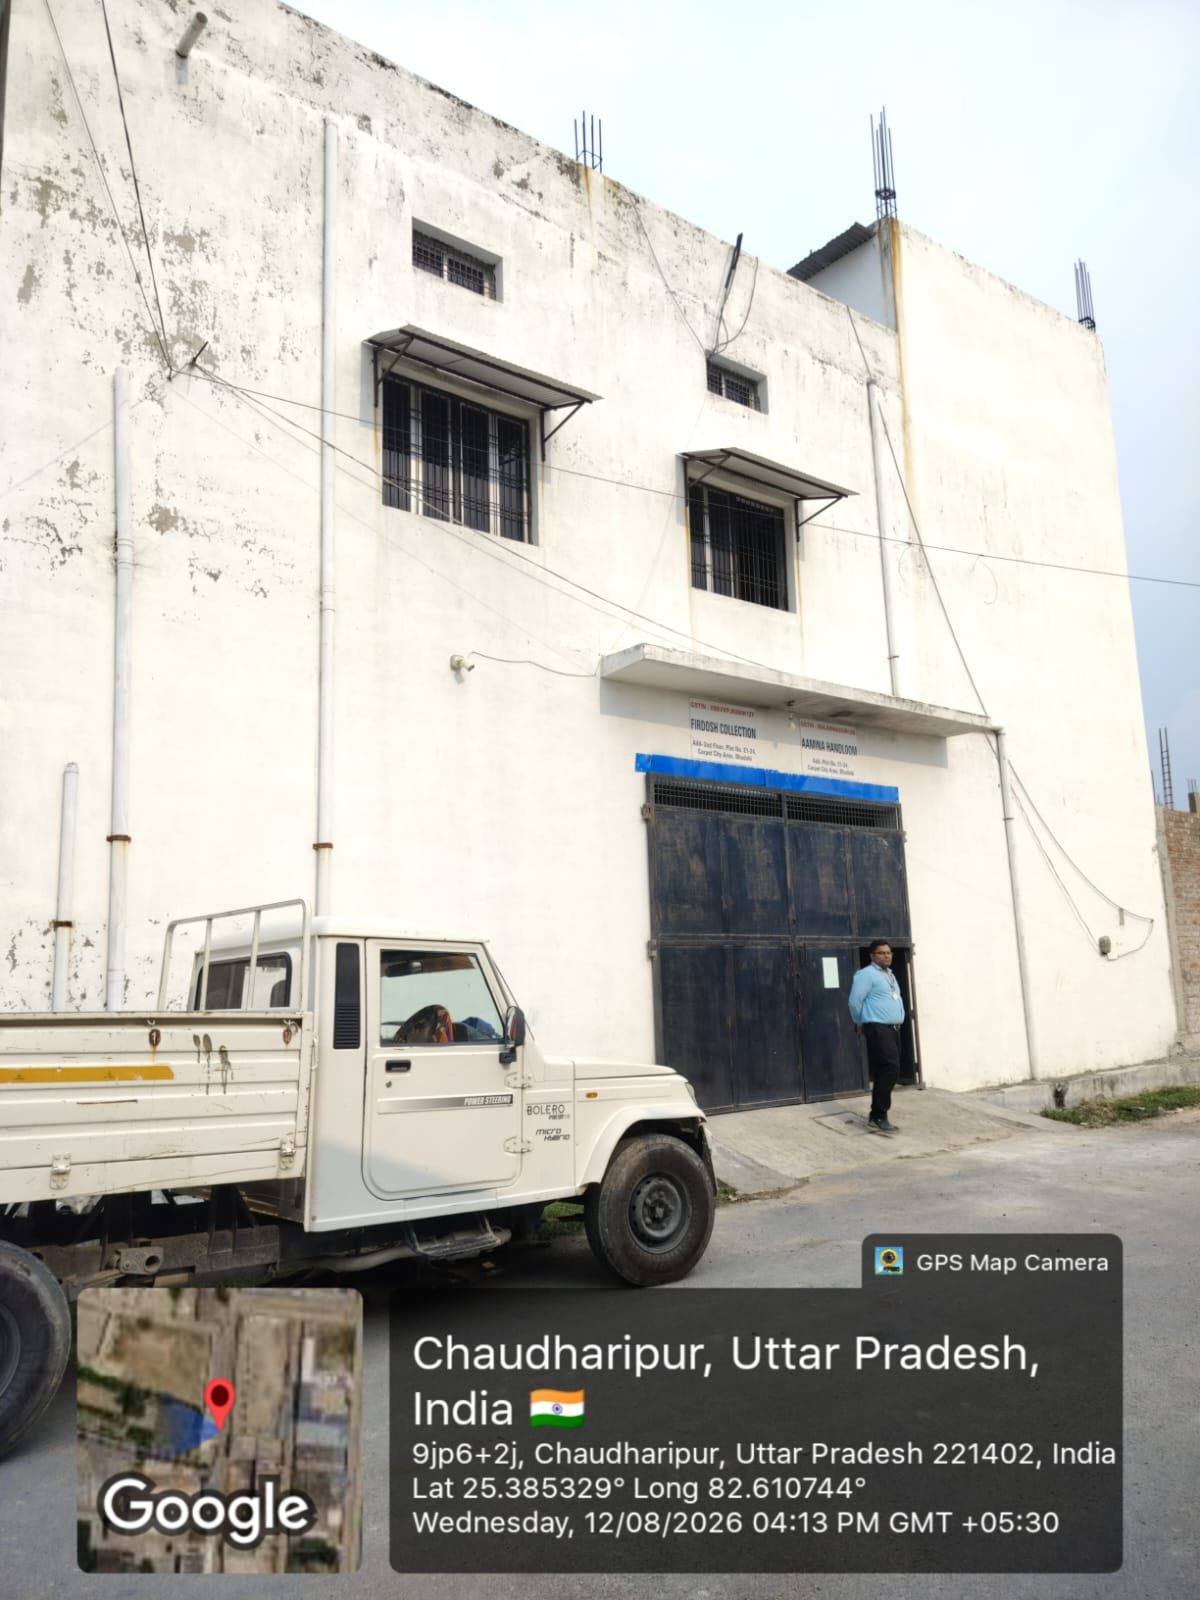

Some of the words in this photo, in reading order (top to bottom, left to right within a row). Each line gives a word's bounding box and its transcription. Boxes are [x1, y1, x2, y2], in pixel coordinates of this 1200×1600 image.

[690, 718, 719, 733] FIRDOSH
[720, 723, 757, 739] COLLECTION
[463, 1096, 484, 1106] POWER
[485, 1095, 511, 1105] STEERING
[527, 1104, 566, 1116] BOLERO
